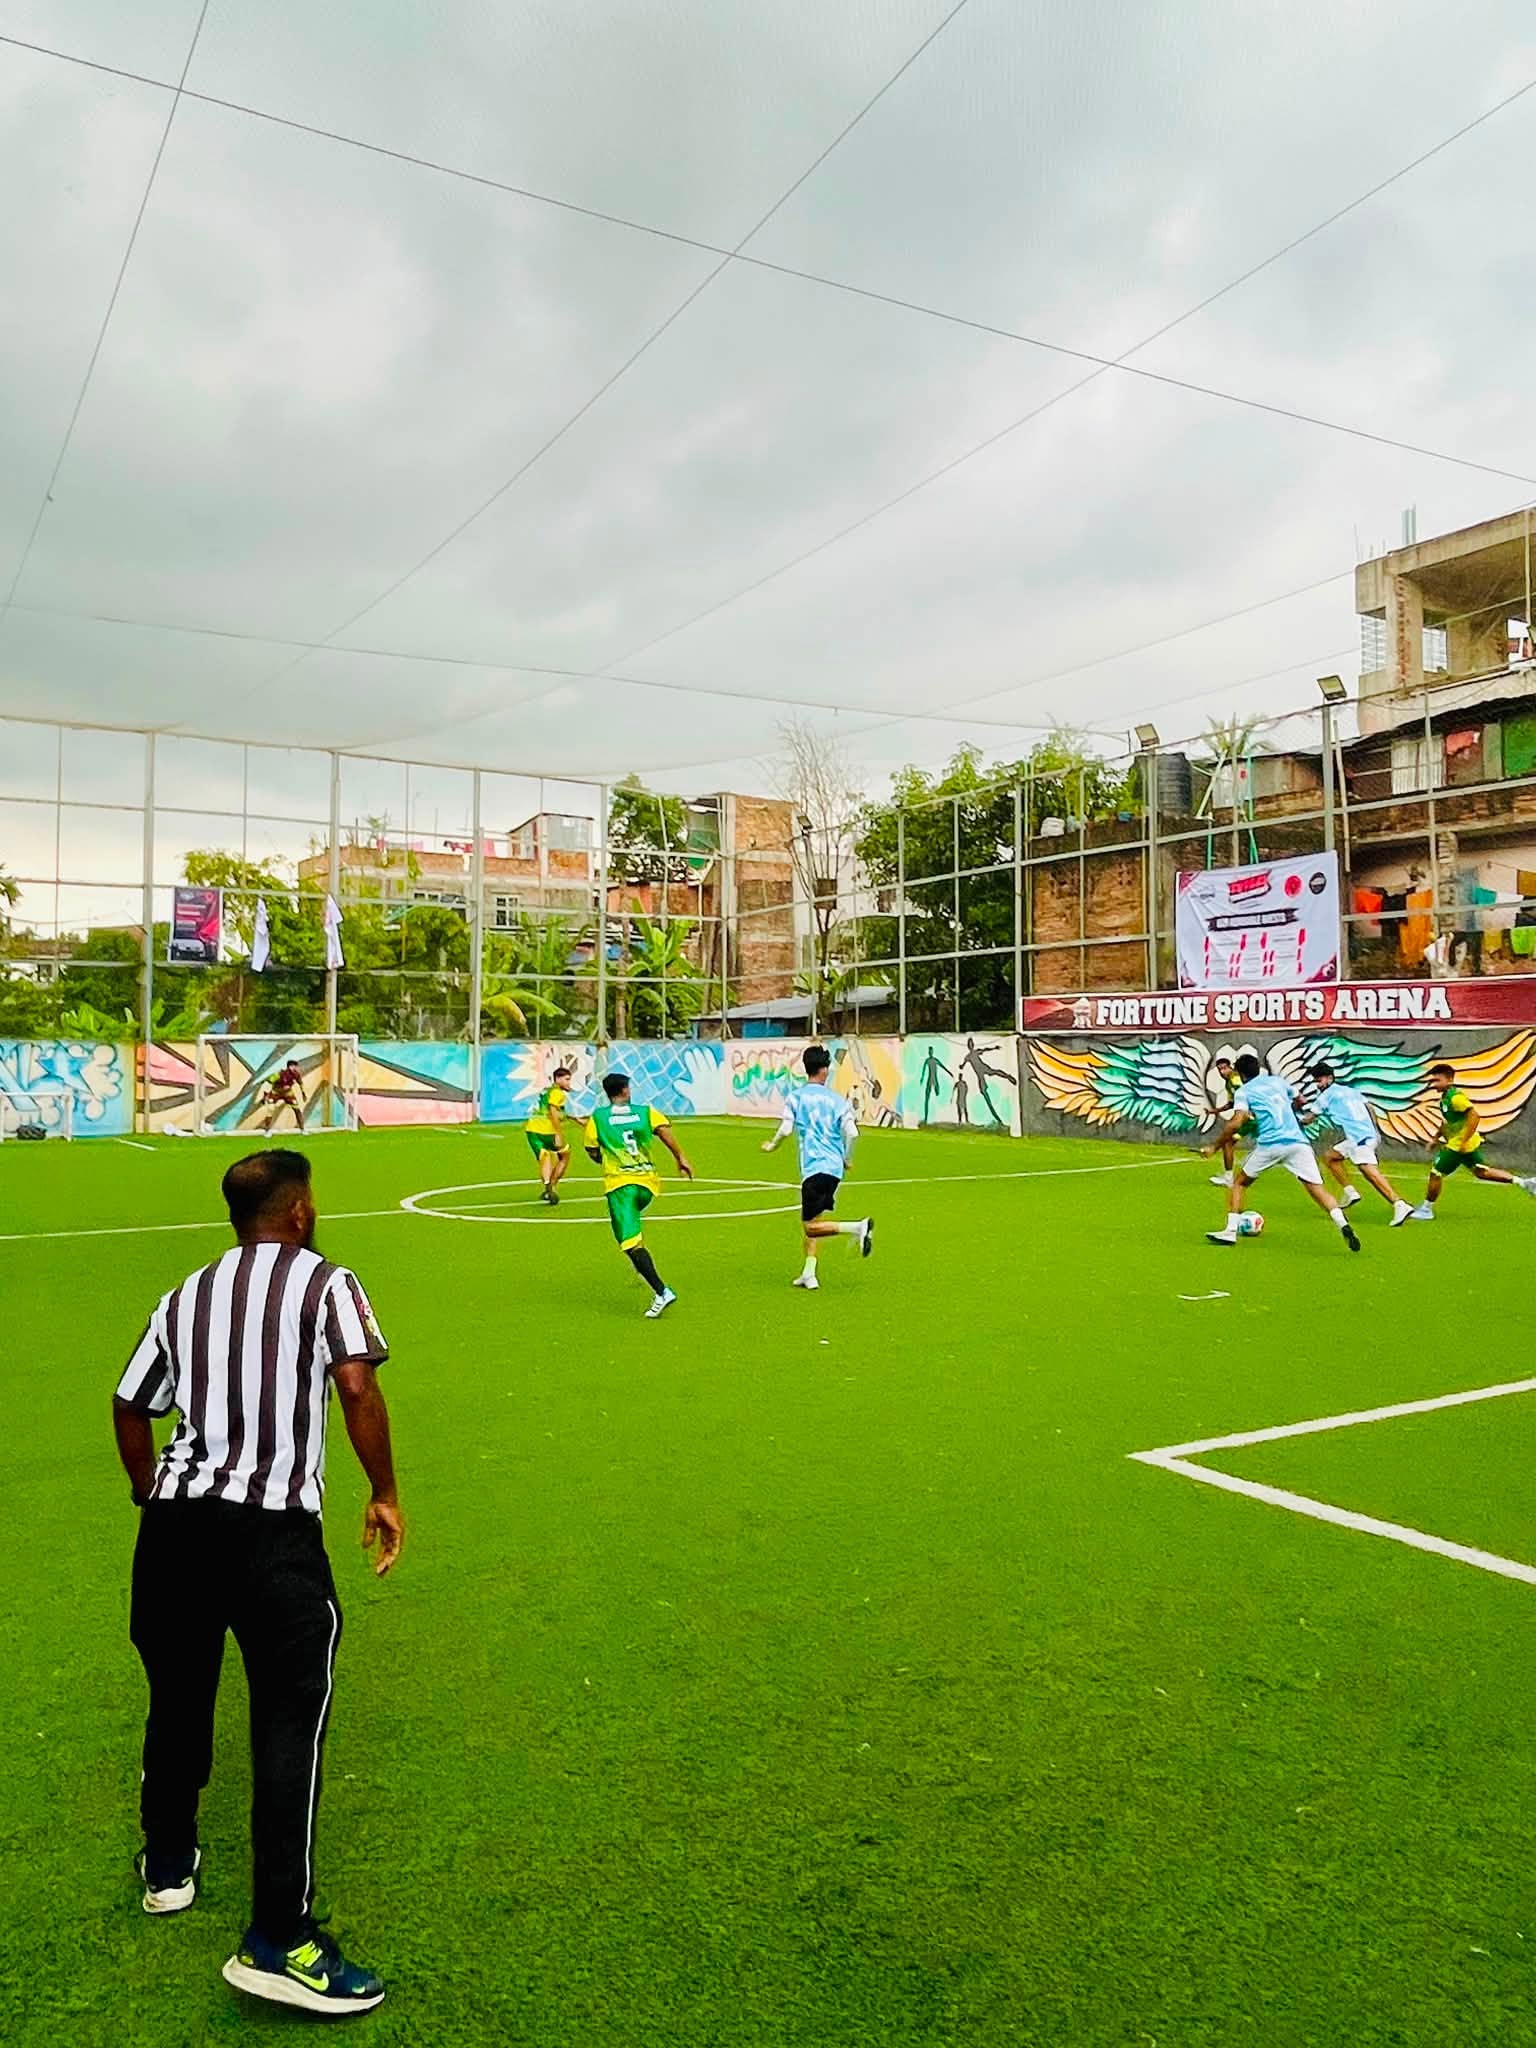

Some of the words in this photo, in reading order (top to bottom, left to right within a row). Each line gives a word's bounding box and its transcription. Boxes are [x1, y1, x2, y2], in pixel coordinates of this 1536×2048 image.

[1096, 997, 1208, 1025] FORTUNE
[1214, 992, 1325, 1023] SPORTS
[1331, 987, 1452, 1020] ARENA
[622, 1130, 639, 1156] 5
